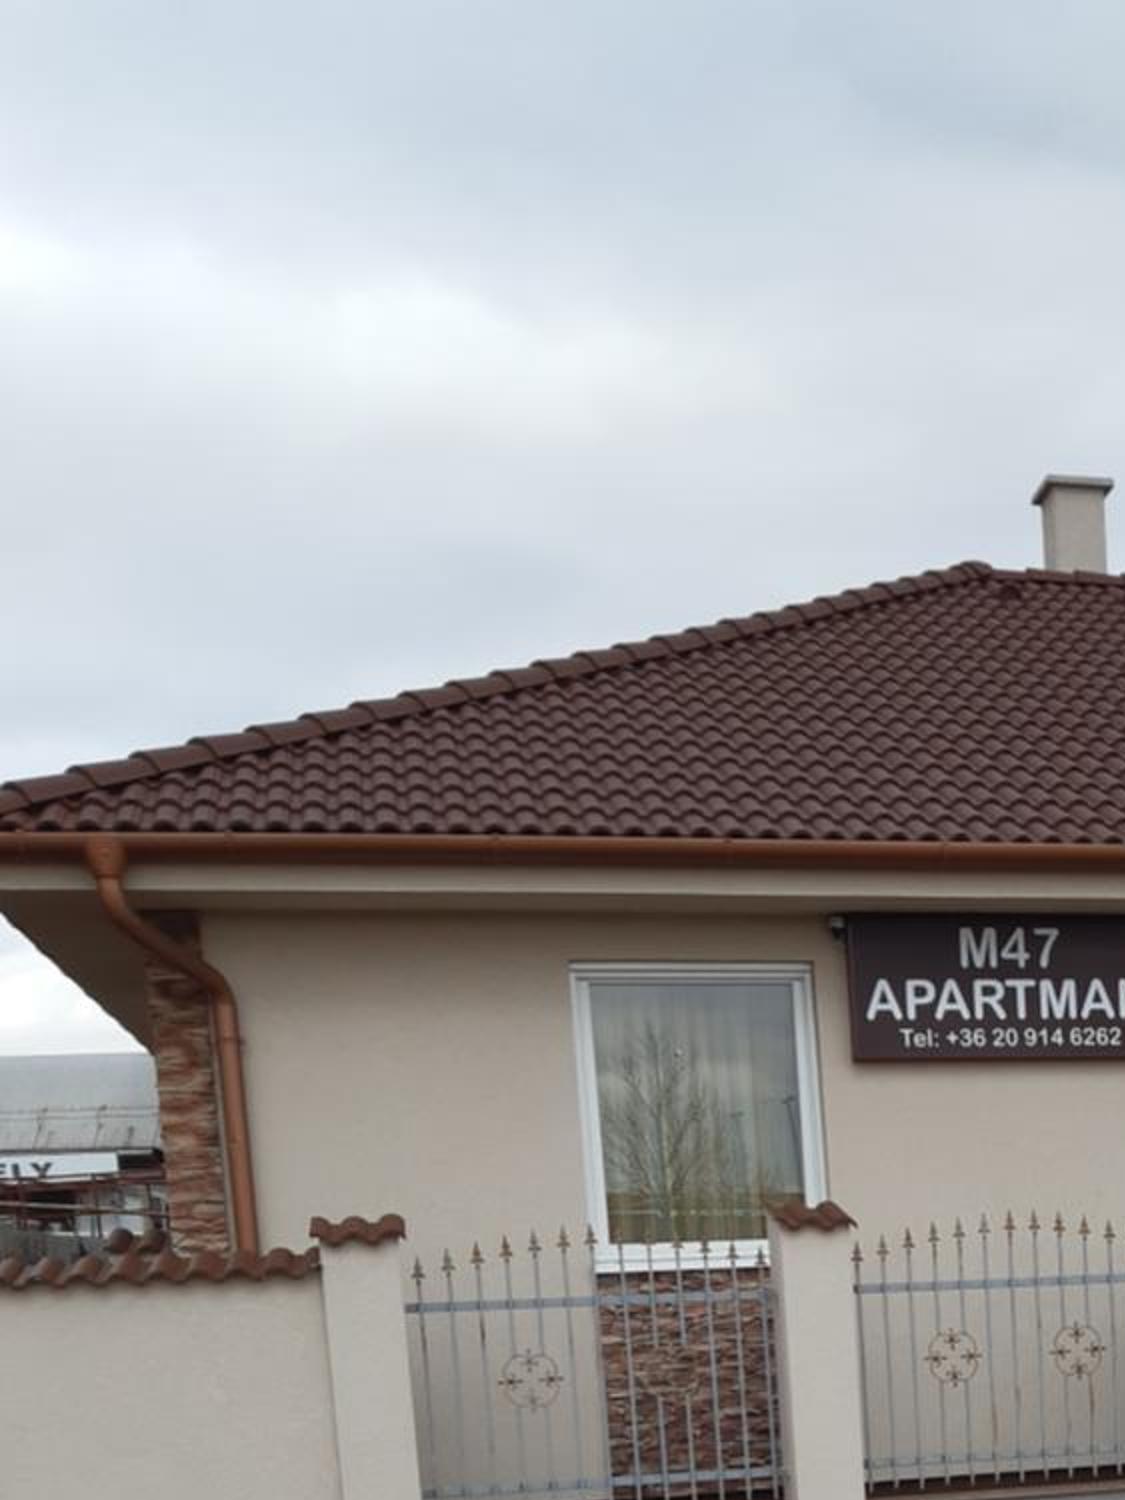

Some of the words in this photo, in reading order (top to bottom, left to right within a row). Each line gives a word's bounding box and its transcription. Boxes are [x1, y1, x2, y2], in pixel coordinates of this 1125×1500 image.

[958, 926, 1060, 969] M47
[899, 1028, 940, 1048] Tel:
[946, 1028, 987, 1047] +36
[992, 1028, 1019, 1047] 20
[1023, 1027, 1064, 1047] 914
[1069, 1027, 1122, 1047] 6262
